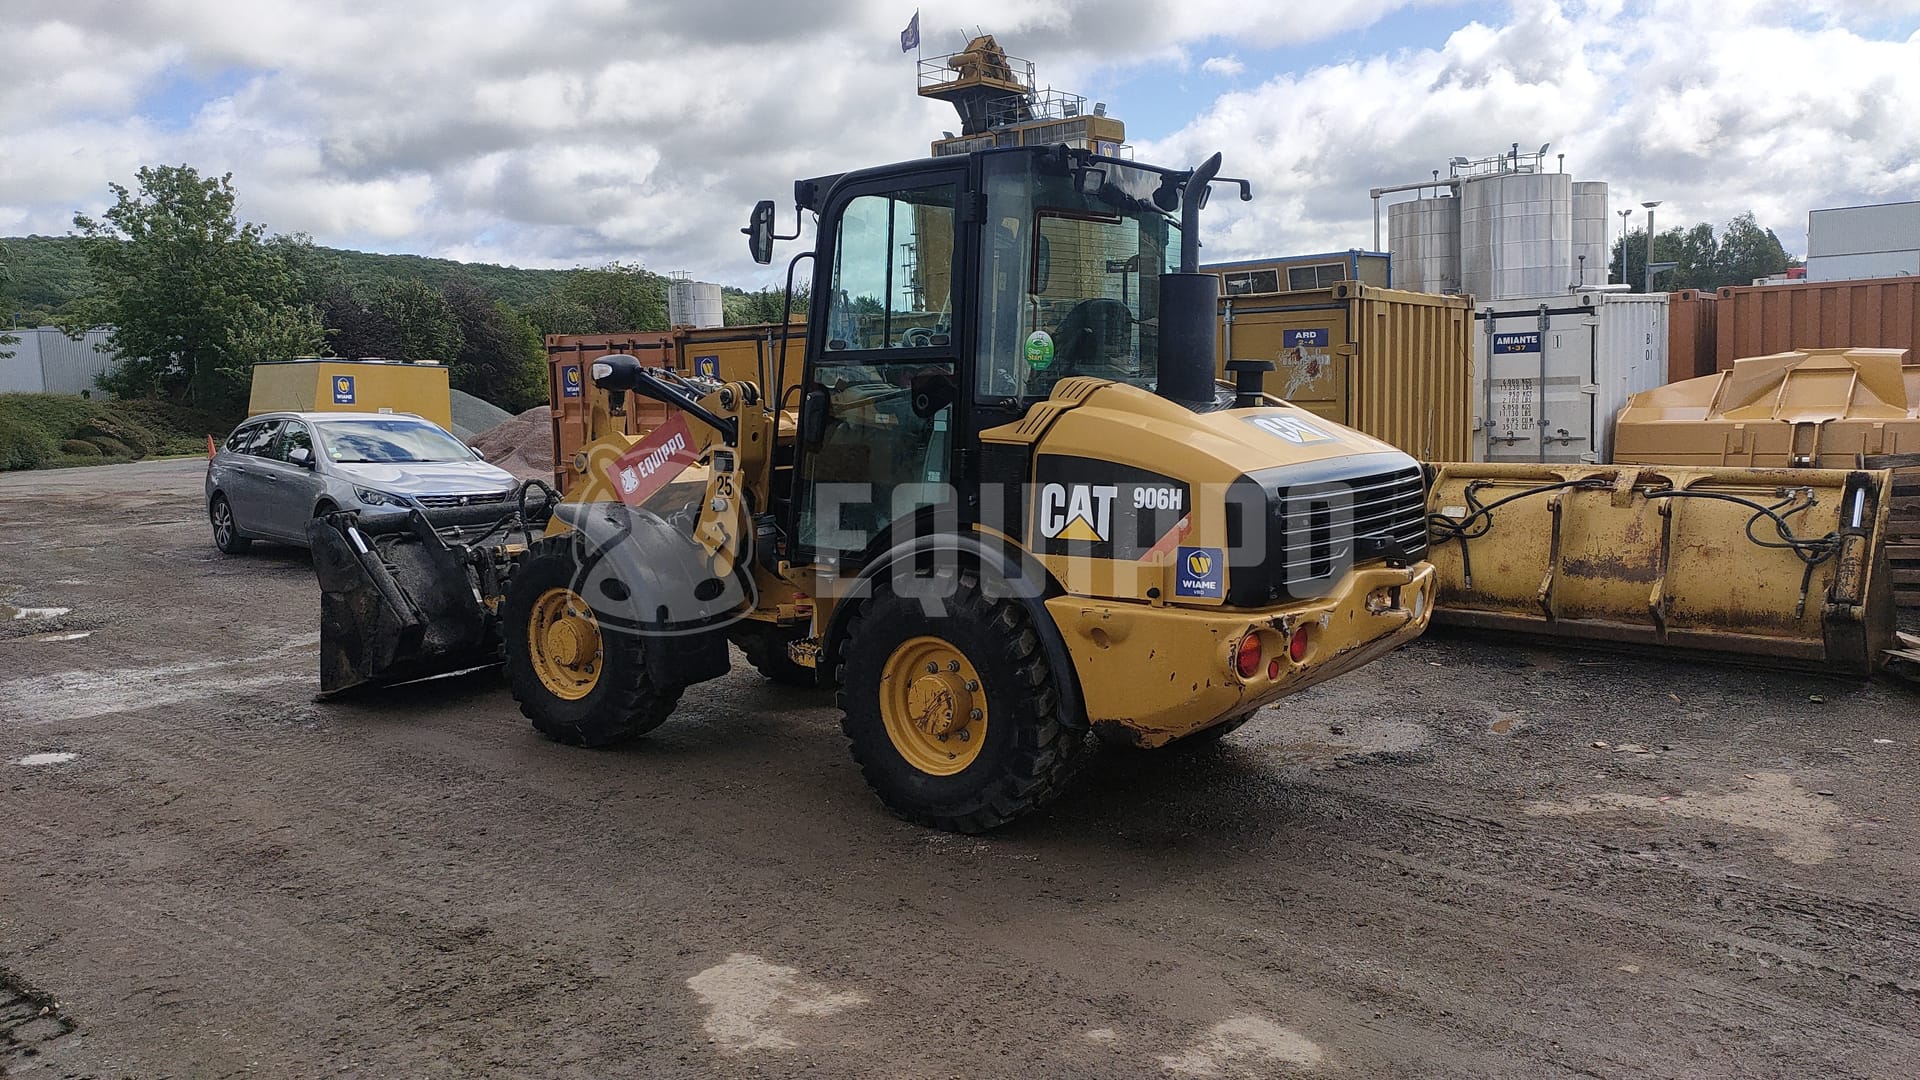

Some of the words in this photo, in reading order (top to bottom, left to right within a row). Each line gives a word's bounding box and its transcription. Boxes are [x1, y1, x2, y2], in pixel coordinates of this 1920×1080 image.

[1295, 331, 1317, 339] ARD
[1497, 335, 1538, 345] AMIANTE
[1253, 417, 1336, 442] CAT
[637, 432, 686, 479] EQUIPPO
[716, 475, 733, 496] 25
[1040, 482, 1118, 542] CAT
[1133, 487, 1183, 510] 906H
[1182, 580, 1217, 590] WIAME
